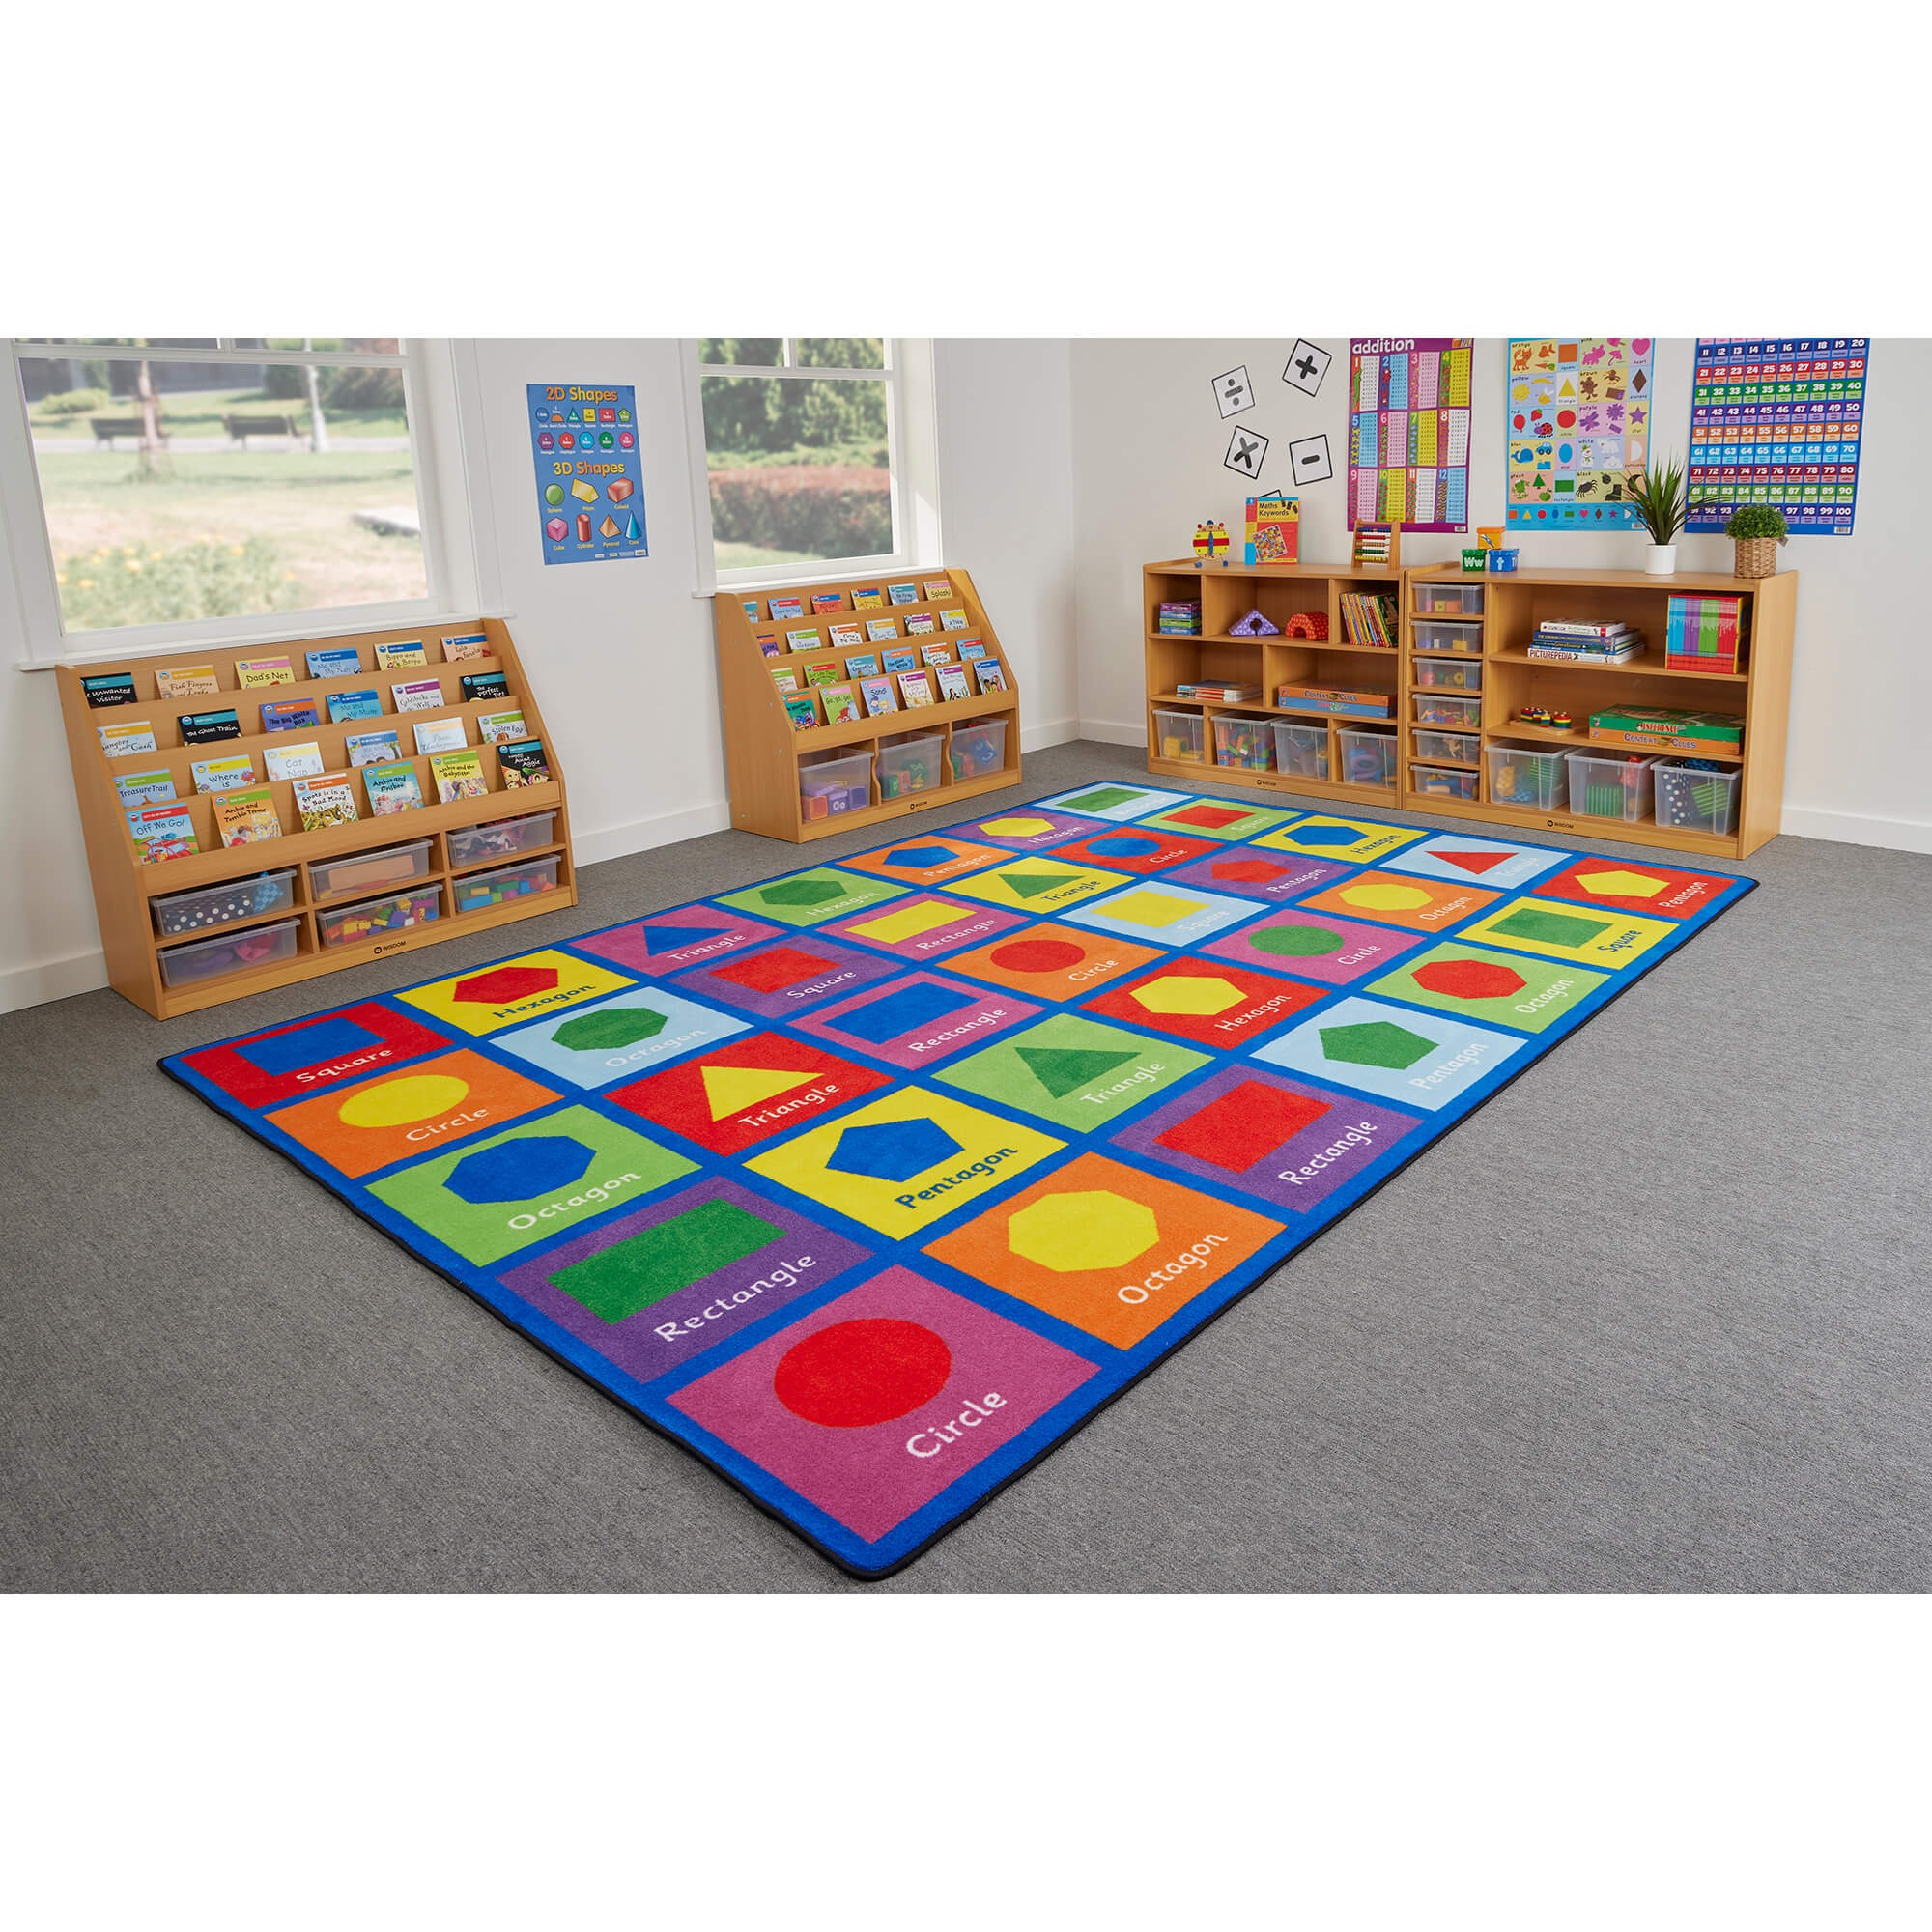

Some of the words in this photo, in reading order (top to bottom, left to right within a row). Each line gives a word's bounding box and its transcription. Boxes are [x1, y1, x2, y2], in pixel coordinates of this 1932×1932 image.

[1352, 339, 1415, 355] addition
[1717, 347, 1726, 355] 12
[1733, 346, 1743, 355] 13
[1766, 344, 1776, 353] 15
[1782, 343, 1793, 352] 16
[1800, 342, 1810, 351] 17
[1817, 341, 1828, 350] 18
[1835, 339, 1846, 349] 19
[1851, 338, 1865, 348] 20
[1354, 356, 1359, 367] 1
[1382, 355, 1390, 366] 2
[1411, 354, 1418, 364] 3
[1442, 352, 1449, 362] 4
[1714, 367, 1726, 376] 22
[1797, 363, 1809, 372] 27
[1814, 362, 1828, 371] 28
[1832, 361, 1845, 370] 29
[1849, 360, 1863, 369] 30
[546, 387, 566, 401] 2D
[569, 386, 618, 405] Shapes
[1352, 415, 1359, 426] 5
[1380, 413, 1387, 423] 6
[1411, 412, 1417, 423] 7
[1440, 411, 1448, 421] 8
[1711, 408, 1723, 416] 42
[1727, 407, 1740, 415] 43
[1760, 406, 1773, 414] 45
[1776, 405, 1789, 413] 46
[1810, 404, 1824, 412] 48
[1846, 403, 1860, 412] 50
[554, 462, 573, 475] 3D
[576, 461, 626, 477] Shapes
[1350, 470, 1357, 481] 9
[1379, 470, 1387, 480] 10
[1409, 469, 1415, 479] 11
[1439, 469, 1447, 479] 12
[1835, 507, 1852, 516] 100
[1530, 649, 1573, 661] PICTUREPEDIA
[246, 672, 270, 683] Dad's
[271, 671, 289, 680] Net
[1671, 737, 1697, 749] CLUES
[285, 758, 303, 768] Cat
[209, 772, 239, 783] Where
[120, 787, 152, 798] Treasure
[136, 822, 154, 836] Off
[155, 819, 167, 829] We
[169, 818, 185, 828] Go!
[1150, 849, 1189, 864] Circle
[1350, 834, 1402, 856] Hexagon
[923, 853, 992, 877] Pentagon
[1040, 879, 1101, 902] Triangle
[1266, 867, 1328, 894] Pentagon
[806, 891, 882, 917] Hexagon
[1658, 880, 1708, 909] Pentagon
[1419, 895, 1473, 922] Octagon
[916, 918, 998, 951] Rectangle
[1598, 928, 1644, 952] Square
[668, 933, 747, 962] Triangle
[1337, 944, 1382, 966] Circle
[1067, 958, 1120, 982] Circle
[787, 970, 857, 1000] Square
[1514, 977, 1575, 1014] Octagon
[492, 983, 596, 1019] Hexagon
[1214, 993, 1292, 1032] Hexagon
[908, 1008, 1008, 1053] Rectangle
[605, 1028, 708, 1068] Octagon
[296, 1048, 393, 1084] Square
[1407, 1041, 1490, 1090] Pentagon
[1080, 1060, 1166, 1107] Triangle
[737, 1082, 840, 1129] Triangle
[405, 1106, 490, 1143] Circle
[1278, 1119, 1378, 1185] Rectangle
[894, 1145, 1019, 1209] Pentagon
[508, 1170, 642, 1231] Octagon
[1117, 1232, 1230, 1305] Octagon
[653, 1252, 817, 1343] Rectangle
[905, 1390, 1009, 1459] Circle
